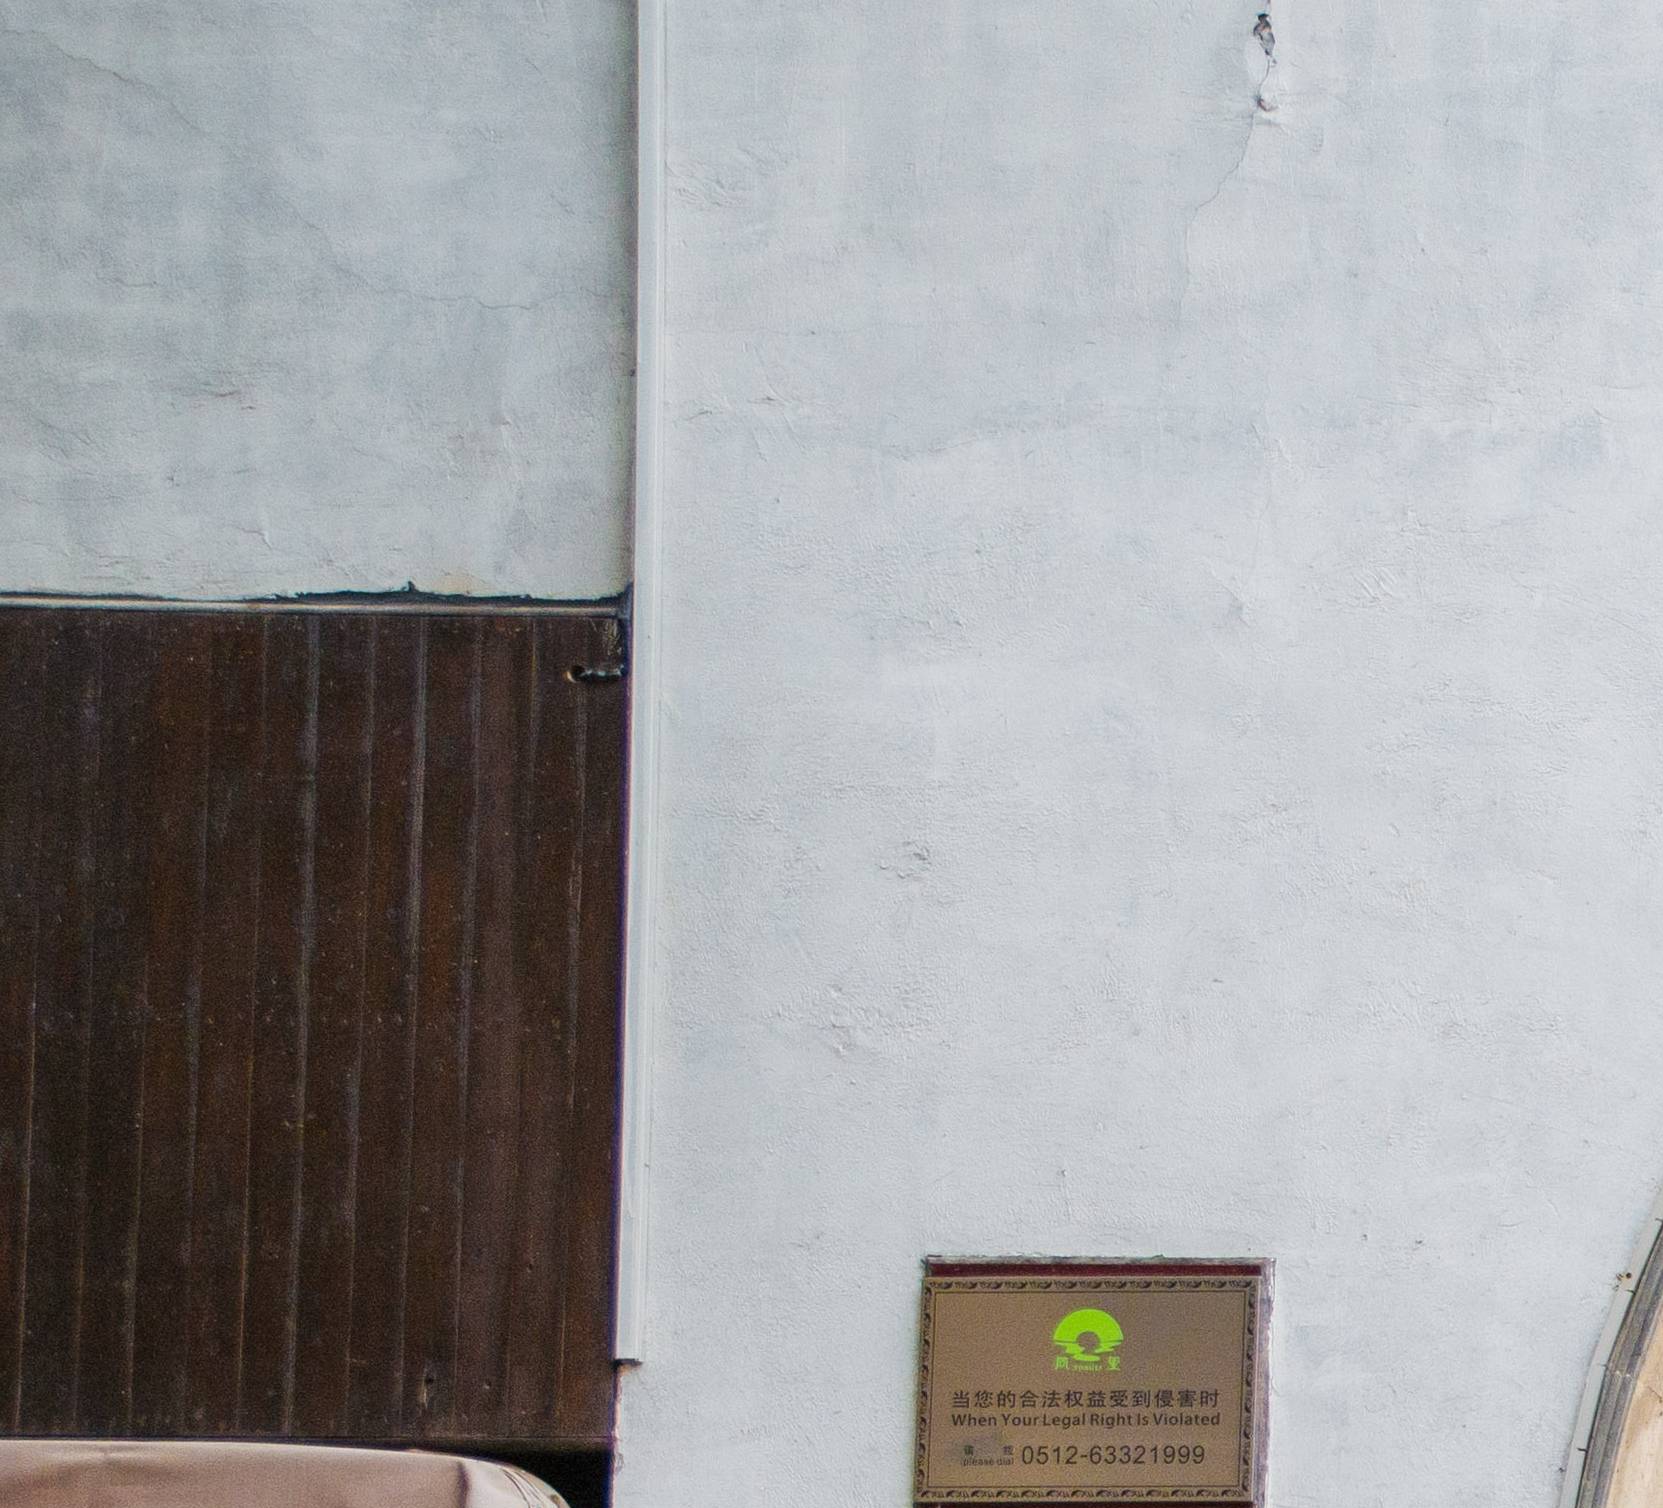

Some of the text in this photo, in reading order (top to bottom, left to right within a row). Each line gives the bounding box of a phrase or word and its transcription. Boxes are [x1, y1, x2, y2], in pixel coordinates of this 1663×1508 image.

[952, 1388, 1219, 1409] 当您的合法权益受到侵害时
[952, 1412, 1221, 1430] When Your Legal Right Is Violated
[1022, 1445, 1206, 1465] 0512-63321999
